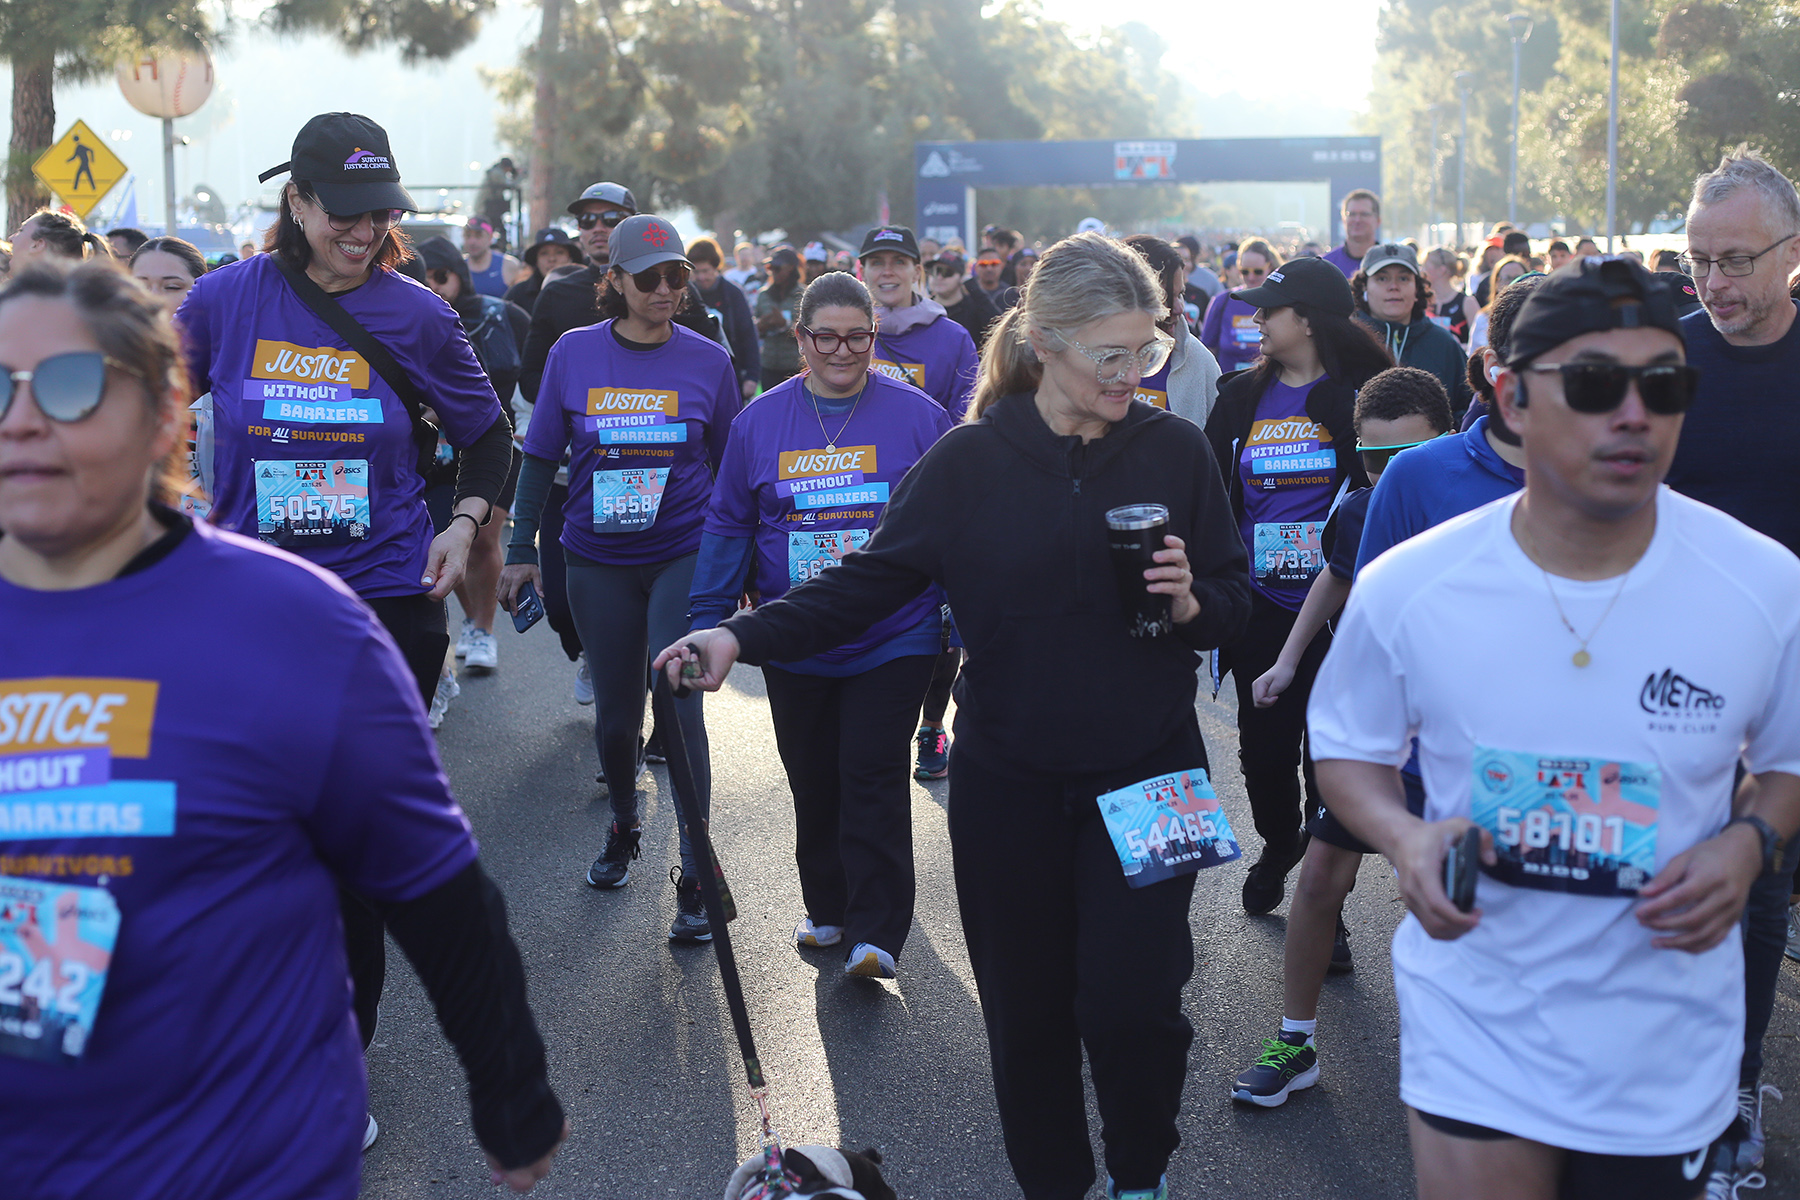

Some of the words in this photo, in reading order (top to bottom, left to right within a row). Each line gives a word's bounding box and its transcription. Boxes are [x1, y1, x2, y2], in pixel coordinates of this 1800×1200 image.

[265, 349, 356, 382] JUSTICE
[263, 384, 338, 400] WITHOUT
[595, 392, 668, 410] JUSTICE
[280, 403, 369, 421] BARRIERS
[596, 415, 656, 429] WITHOUT
[248, 426, 272, 436] FOR
[272, 428, 289, 438] ALL
[291, 430, 365, 442] SURVIVORS
[611, 431, 678, 441] BARRIERS
[1252, 422, 1322, 442] JUSTICE
[593, 448, 608, 456] FOR
[607, 448, 620, 456] ALL
[621, 448, 675, 457] SURVIVORS
[1251, 443, 1310, 459] WITHOUT
[787, 451, 866, 474] JUSTICE
[1264, 457, 1331, 471] BARRIERS
[789, 474, 853, 493] WITHOUT
[1263, 478, 1275, 486] ALL
[1276, 476, 1330, 486] SURVIVORS
[270, 495, 356, 520] 50575
[807, 491, 878, 506] BARRIERS
[786, 513, 803, 522] FOR
[803, 513, 816, 521] ALL
[817, 511, 875, 521] SURVIVORS
[1265, 548, 1323, 569] 57321
[1640, 667, 1725, 713] METRO
[1124, 809, 1218, 859] 54465
[1497, 805, 1625, 856] 58101
[0, 951, 87, 1014] 242
